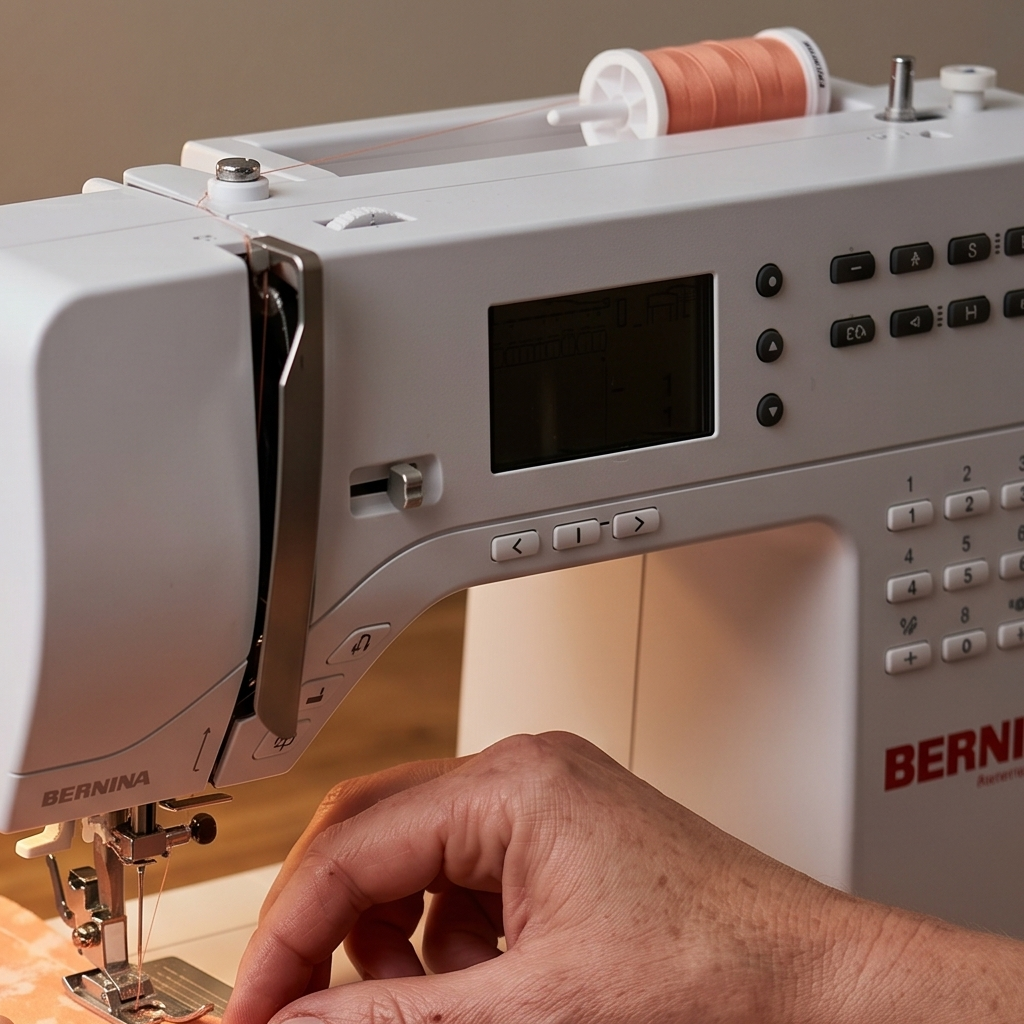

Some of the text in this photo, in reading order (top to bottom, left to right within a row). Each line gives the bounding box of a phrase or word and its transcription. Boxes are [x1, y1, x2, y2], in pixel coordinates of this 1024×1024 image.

[968, 243, 977, 258] S
[907, 475, 913, 492] 1
[963, 465, 971, 482] 2
[966, 496, 974, 512] 2
[909, 507, 915, 523] 1
[904, 548, 914, 564] 4
[962, 535, 971, 552] 5
[964, 568, 973, 584] 5
[908, 580, 917, 595] 4
[961, 607, 970, 623] 8
[884, 716, 1024, 792] BERNI
[41, 770, 151, 808] BERNINA
